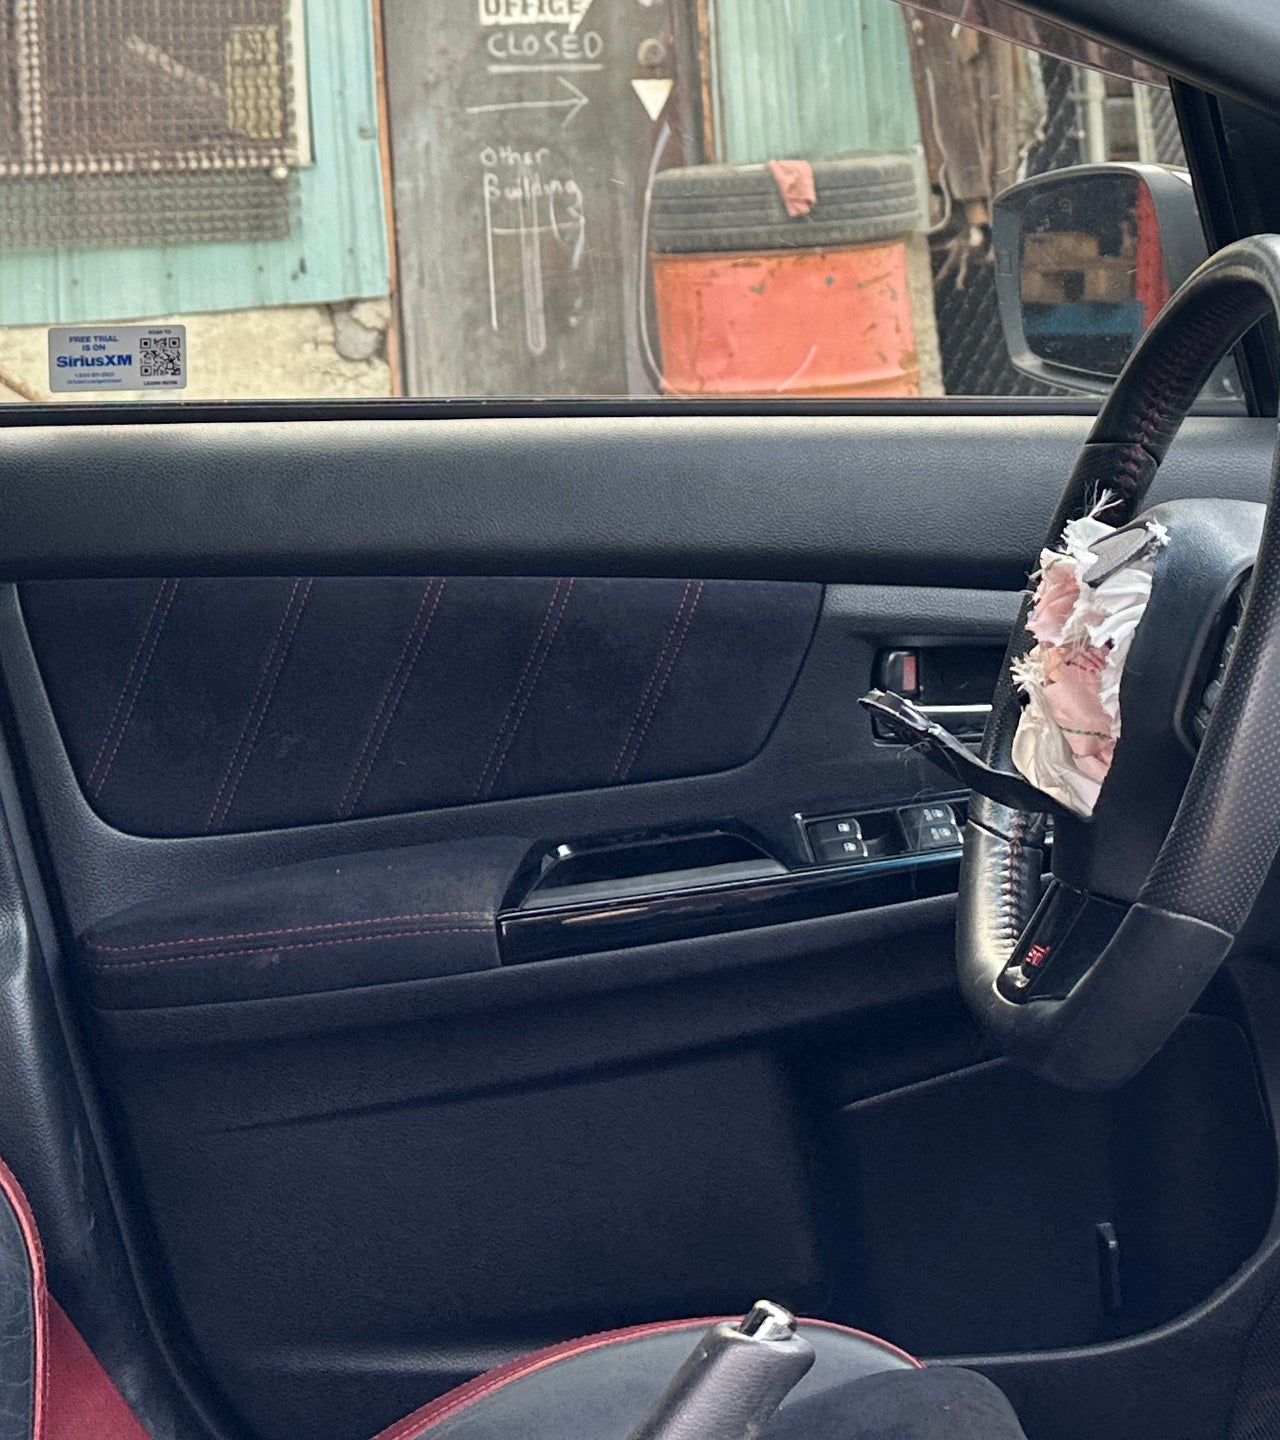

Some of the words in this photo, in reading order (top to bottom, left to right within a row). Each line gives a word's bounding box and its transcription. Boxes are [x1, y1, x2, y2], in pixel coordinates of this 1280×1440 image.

[487, 29, 603, 59] CLOSED
[93, 335, 119, 343] TRIAL
[56, 354, 132, 368] SiriusXM
